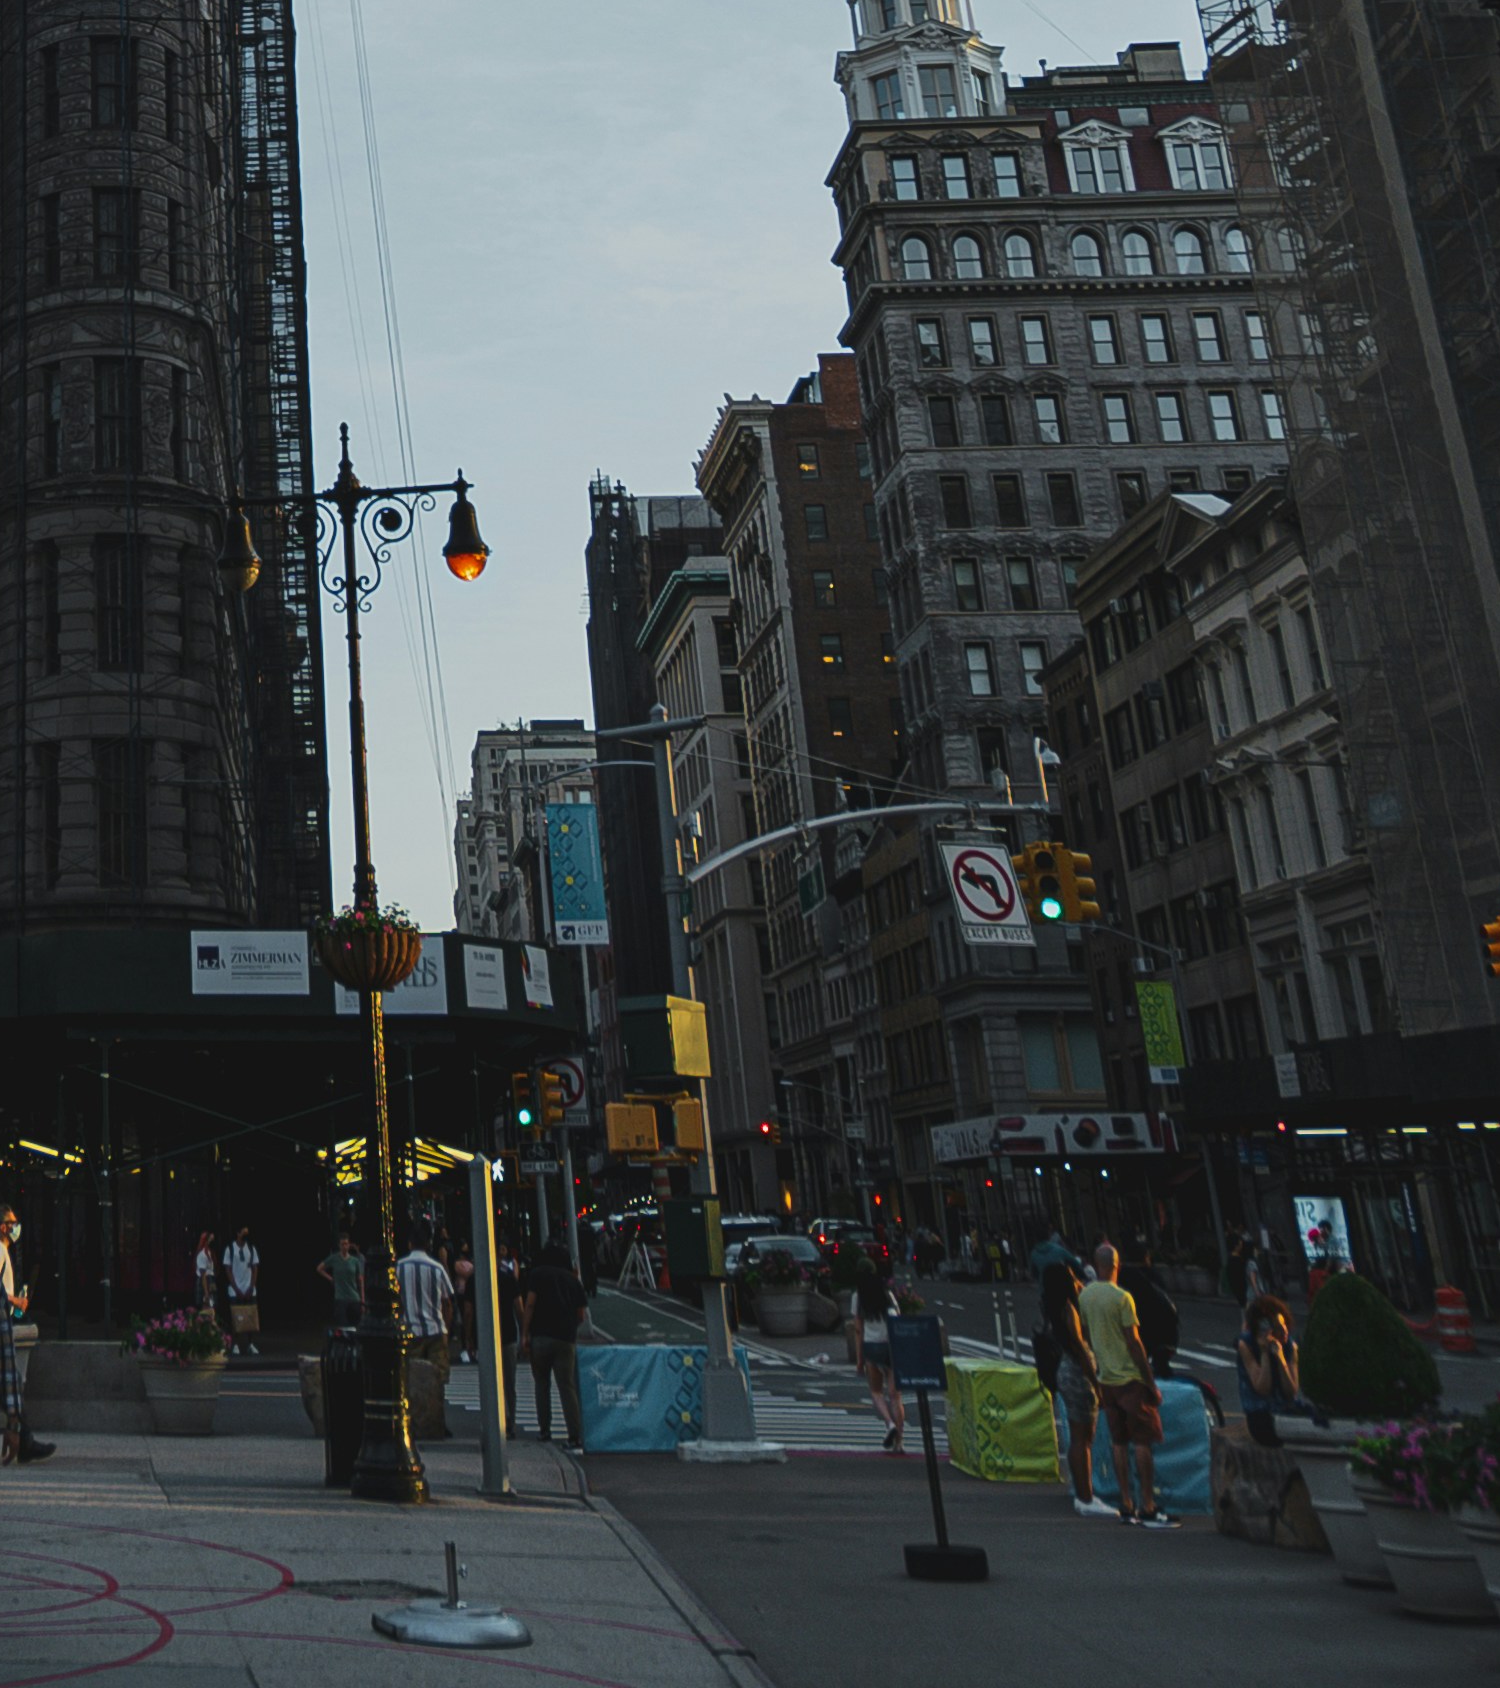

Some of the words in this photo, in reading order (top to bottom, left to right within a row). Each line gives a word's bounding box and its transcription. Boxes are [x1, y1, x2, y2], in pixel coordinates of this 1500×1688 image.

[966, 926, 1000, 940] EXCEPT
[1001, 927, 1032, 941] BUSES
[230, 952, 302, 964] ZIMMERMAN
